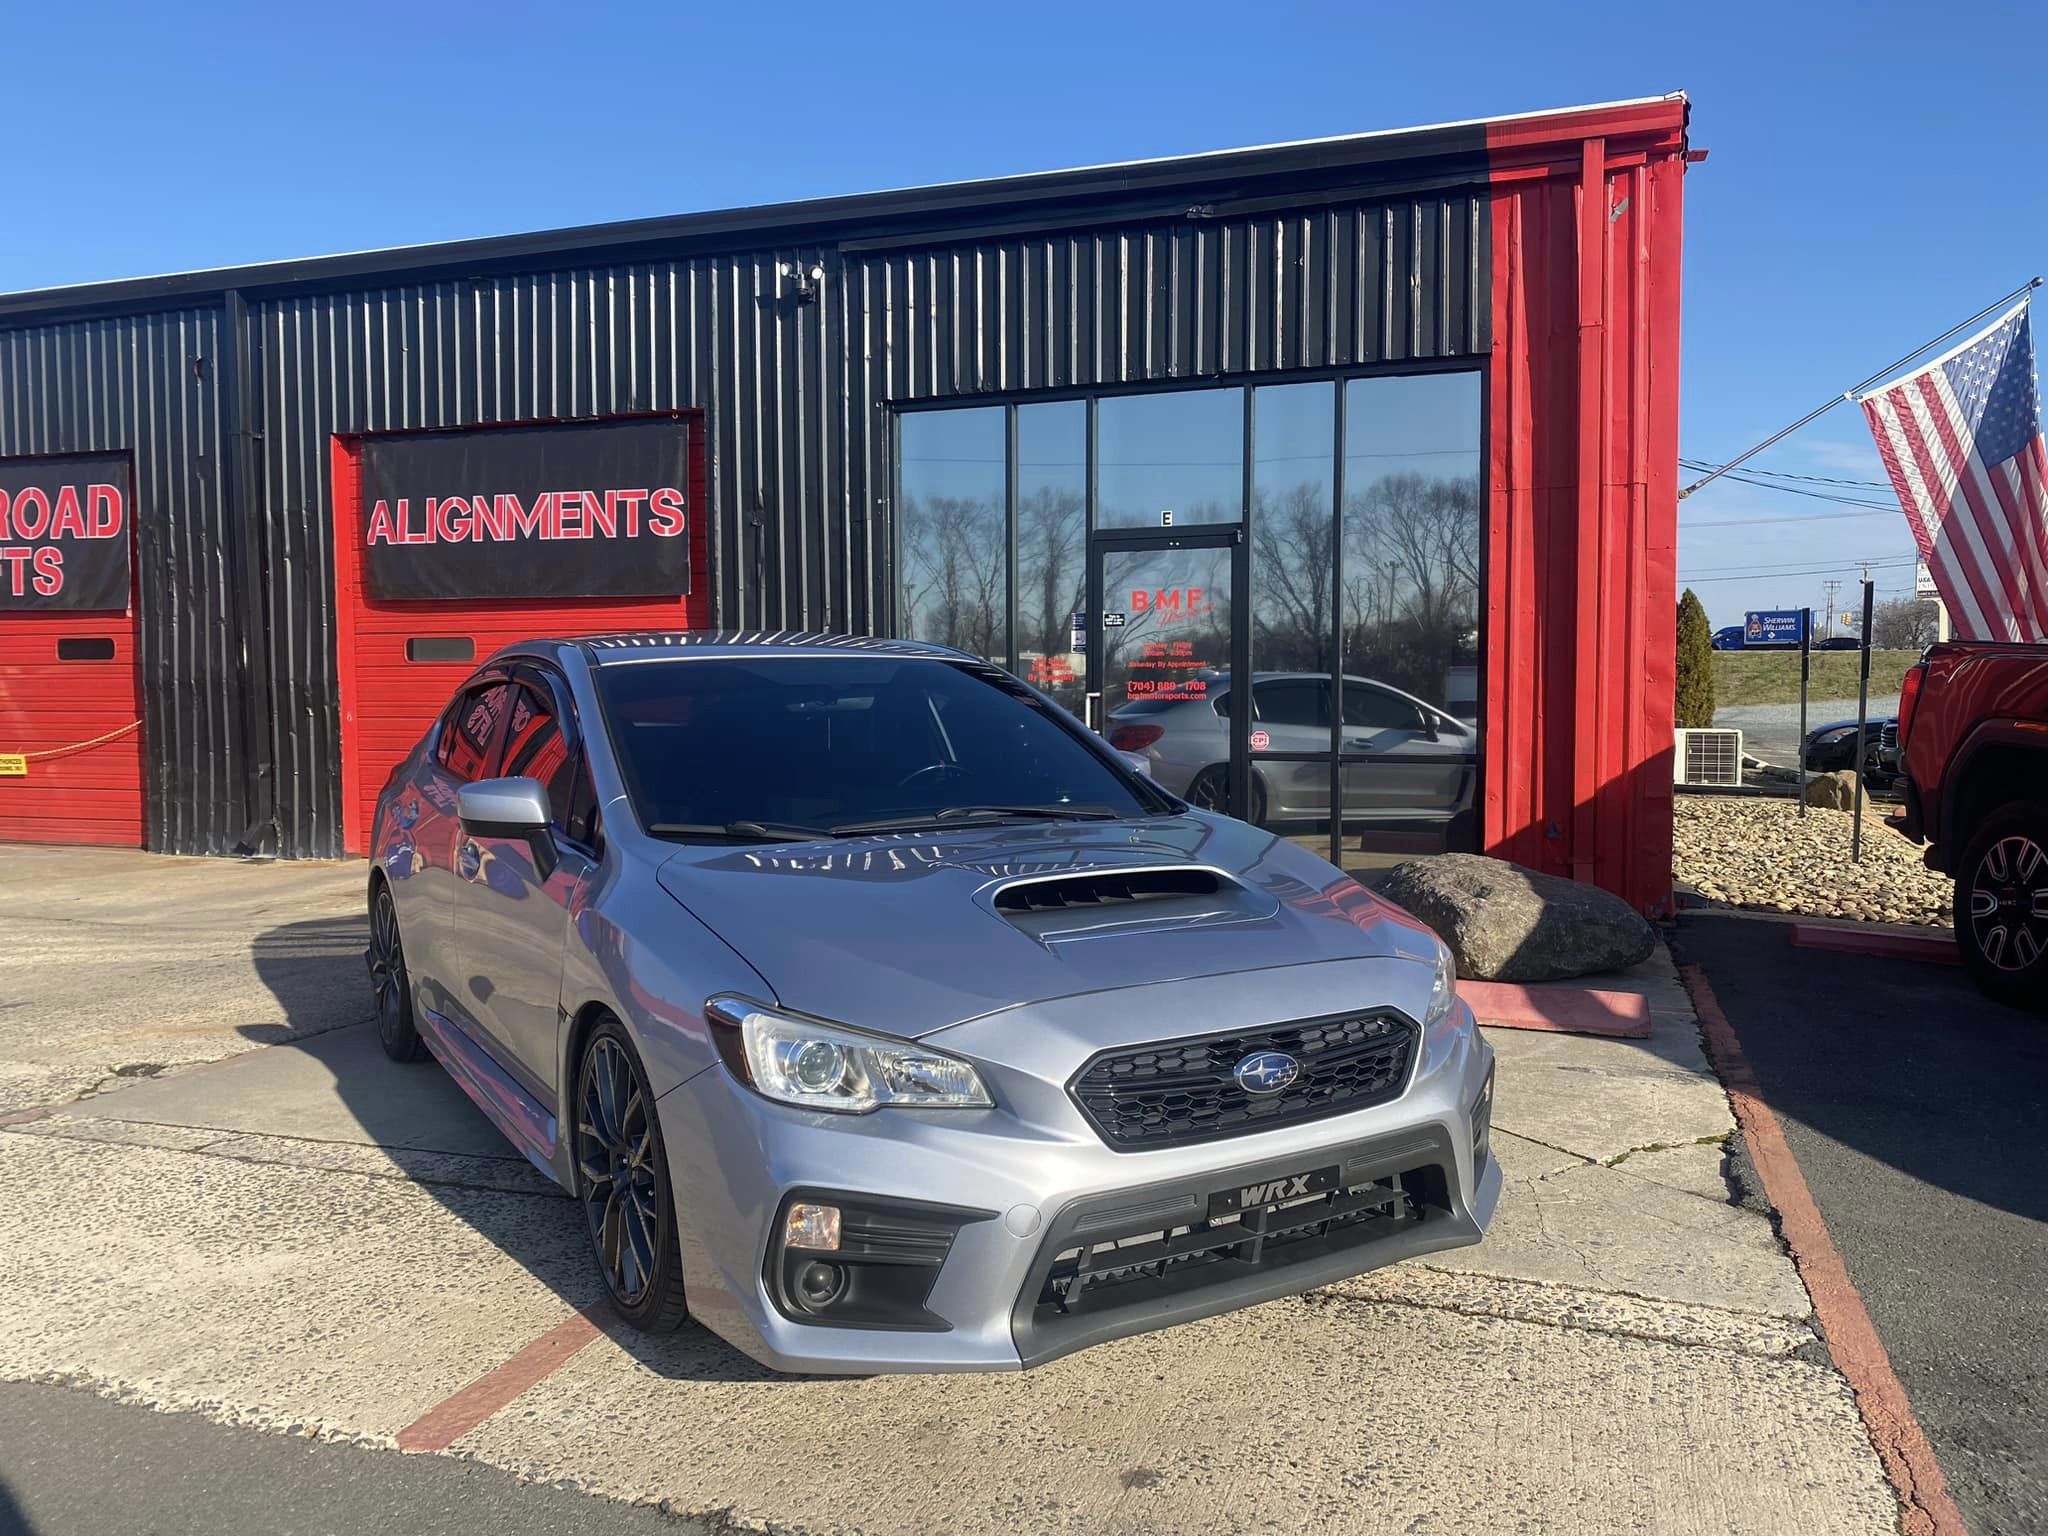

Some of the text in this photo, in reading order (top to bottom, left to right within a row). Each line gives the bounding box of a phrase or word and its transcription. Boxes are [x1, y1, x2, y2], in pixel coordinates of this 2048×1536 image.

[366, 486, 685, 546] ALIGNMENTS
[1162, 512, 1171, 525] E
[0, 546, 64, 596] TS
[1131, 587, 1203, 612] BMF
[1763, 617, 1796, 625] SHERWIN
[1127, 680, 1155, 692] (704)
[1185, 681, 1207, 690] 1708
[1240, 1174, 1311, 1207] WRX
